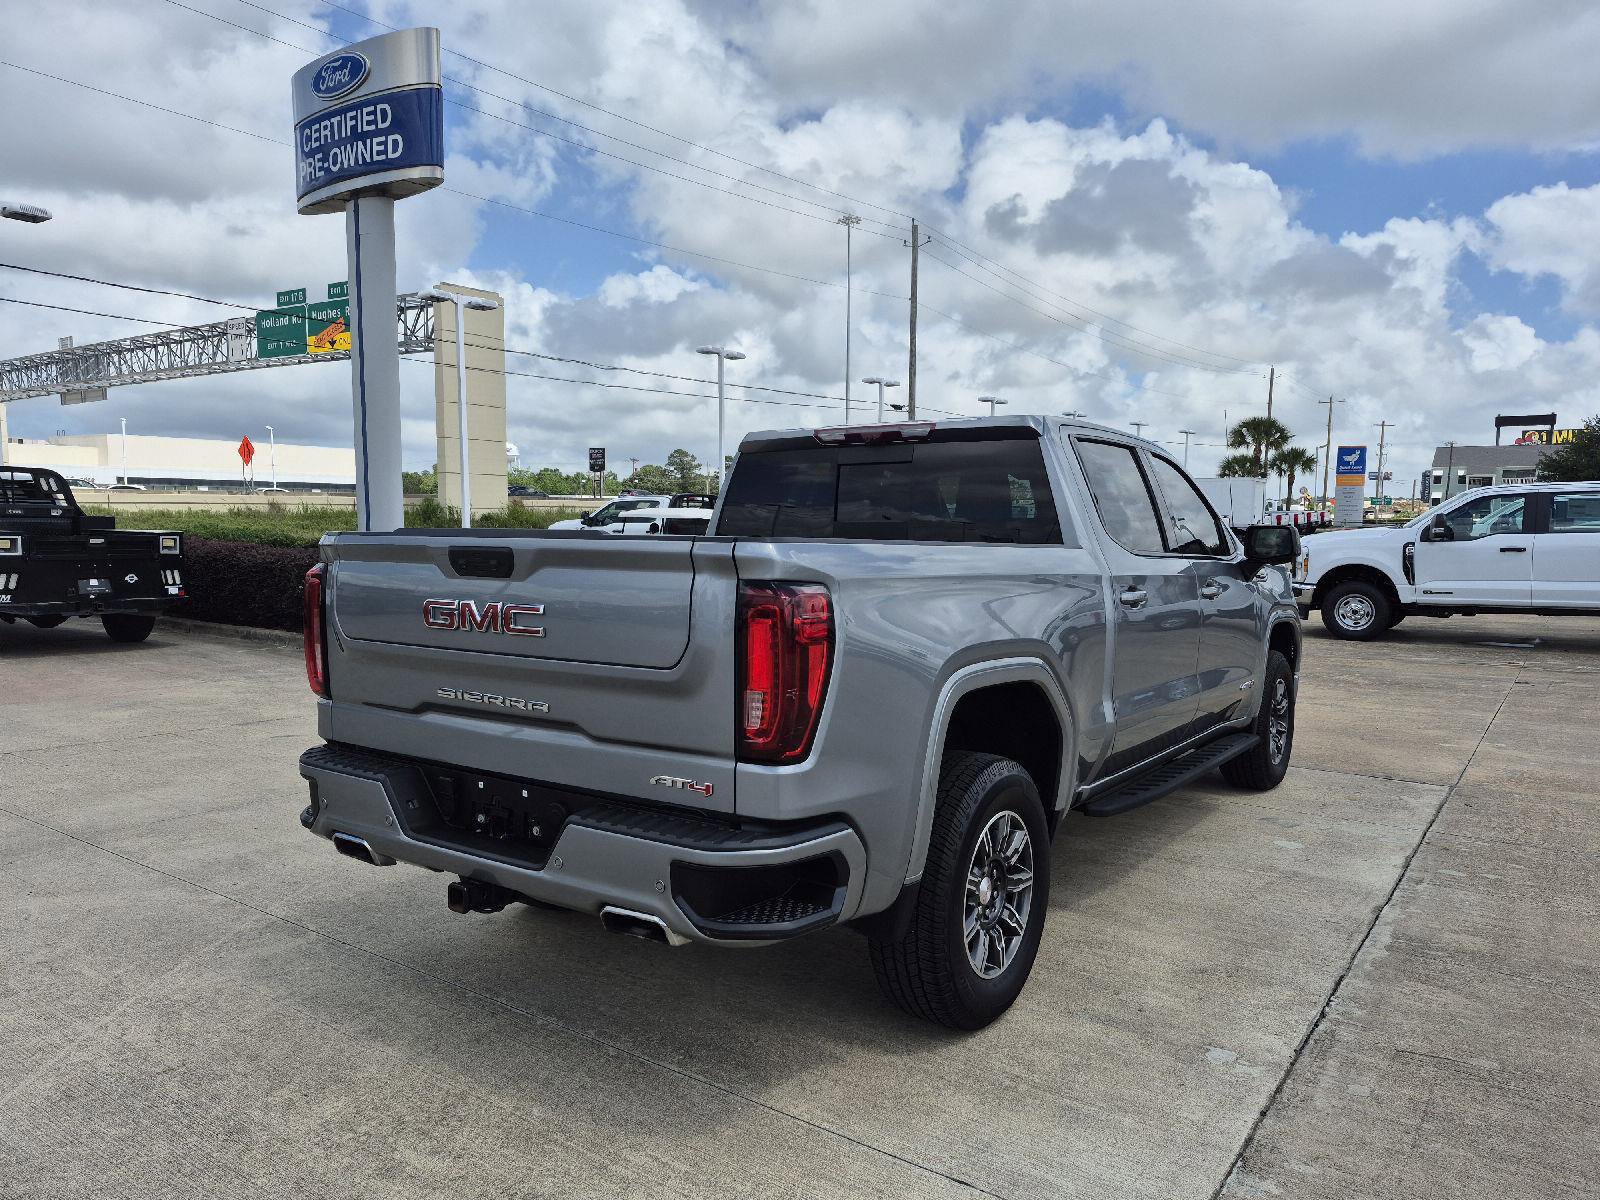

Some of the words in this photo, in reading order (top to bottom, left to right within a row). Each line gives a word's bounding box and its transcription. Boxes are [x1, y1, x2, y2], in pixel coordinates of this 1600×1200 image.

[319, 59, 351, 90] Ford
[303, 103, 392, 152] CERTIFIED
[300, 134, 404, 182] PRE-OWNED
[228, 322, 245, 331] SPEED
[261, 316, 289, 329] Holland
[311, 308, 341, 322] Hughes
[422, 598, 546, 638] GMC
[437, 687, 550, 714] SIERRA
[650, 775, 713, 797] AT4
